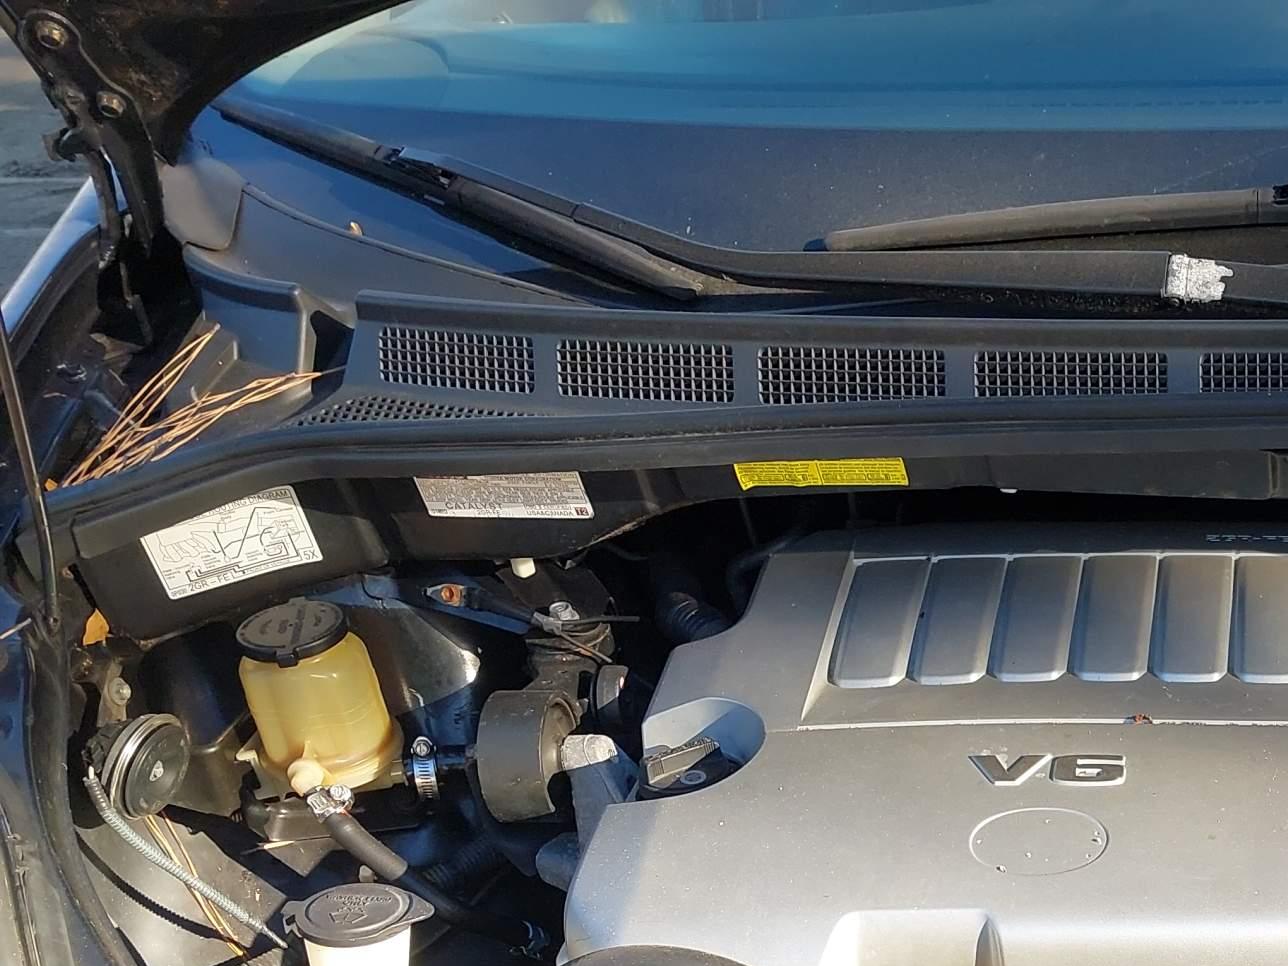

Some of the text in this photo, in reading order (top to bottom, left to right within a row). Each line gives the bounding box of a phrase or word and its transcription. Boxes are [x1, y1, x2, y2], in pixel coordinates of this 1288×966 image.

[247, 489, 289, 505] DIAGRAM
[445, 502, 503, 510] CATALYST
[303, 549, 320, 562] 5X
[968, 752, 1127, 787] V6
